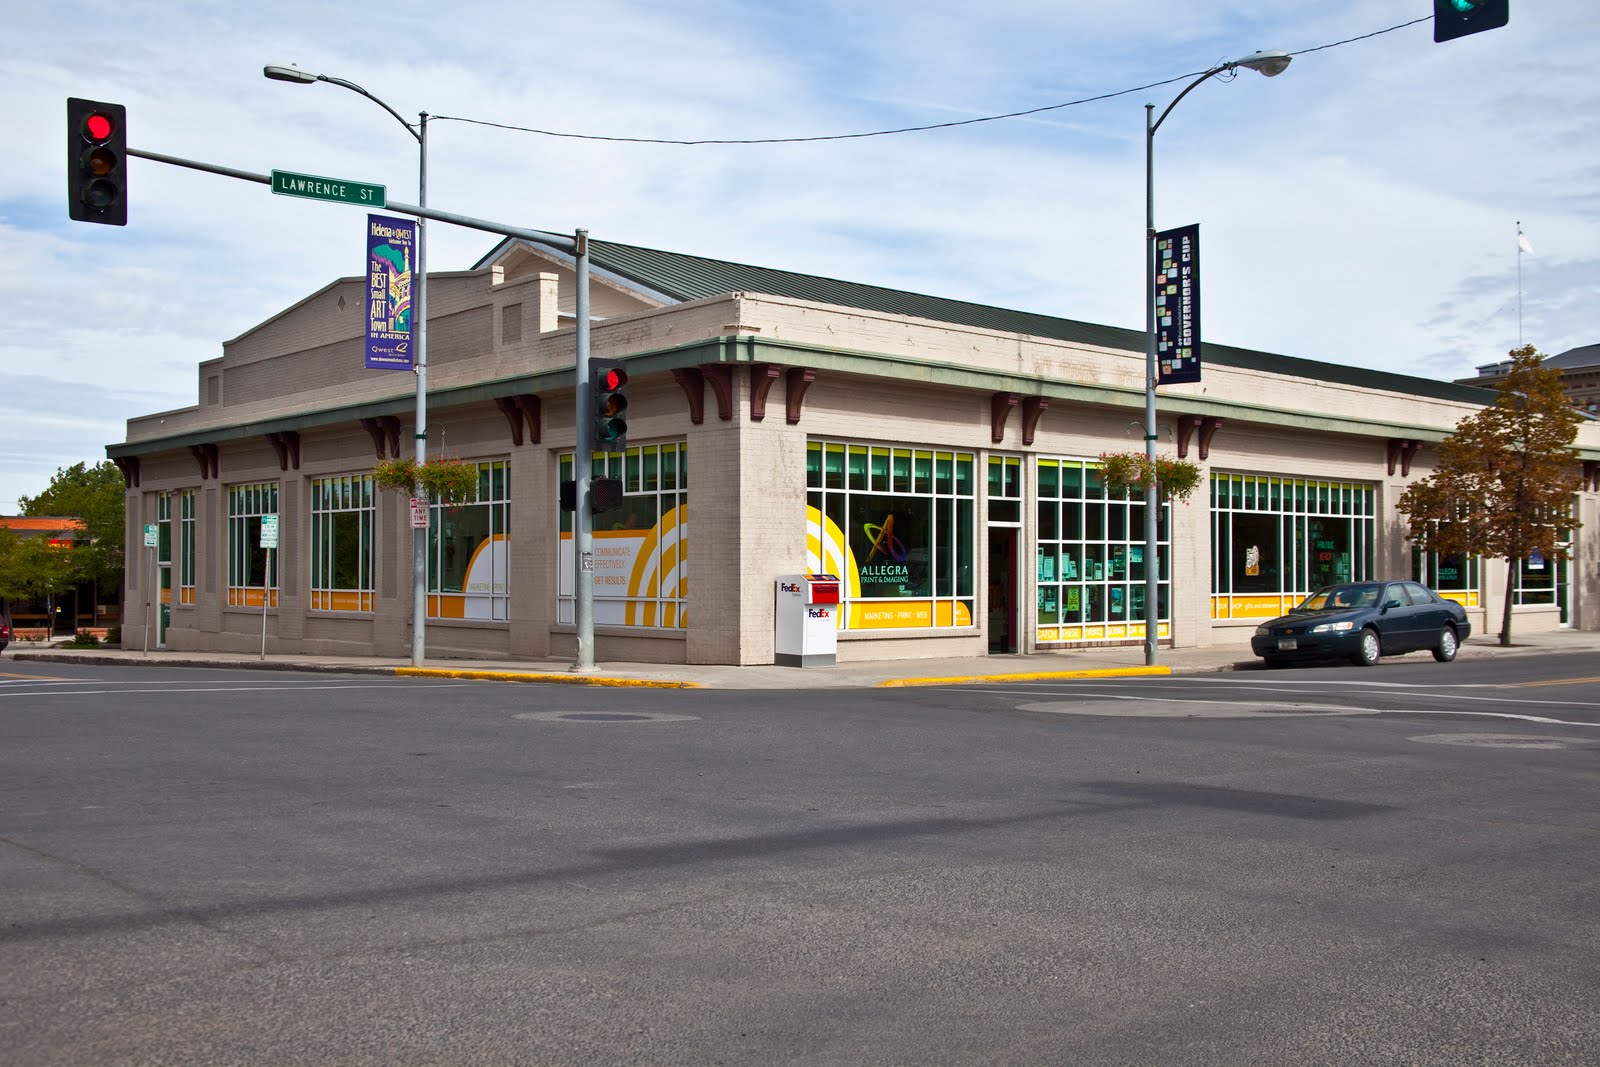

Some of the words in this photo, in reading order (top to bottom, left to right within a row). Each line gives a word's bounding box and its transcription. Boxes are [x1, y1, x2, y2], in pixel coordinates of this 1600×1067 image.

[282, 177, 346, 197] LAWRENCE
[360, 188, 374, 201] ST
[371, 222, 392, 237] Helena
[396, 228, 412, 240] QWEST
[1182, 235, 1191, 262] CUP
[371, 260, 382, 273] The
[371, 272, 388, 289] BEST
[371, 287, 386, 300] Small
[370, 299, 387, 319] ART
[1182, 266, 1192, 346] GOVERNOR'S
[370, 317, 387, 333] Town
[380, 333, 410, 341] AMERICA
[371, 345, 394, 353] Qwest
[413, 514, 428, 522] TIME
[594, 546, 631, 557] COMMUNICATE
[860, 565, 909, 576] ALLEGRA
[594, 575, 604, 585] GET
[883, 575, 909, 583] IMAGING
[781, 582, 801, 593] FedEx
[808, 608, 830, 619] FedEx
[864, 611, 894, 620] MARKETING
[897, 610, 912, 619] PRINT
[916, 610, 928, 619] WEB
[1037, 627, 1057, 639] CATCH
[1062, 626, 1080, 638] THESE
